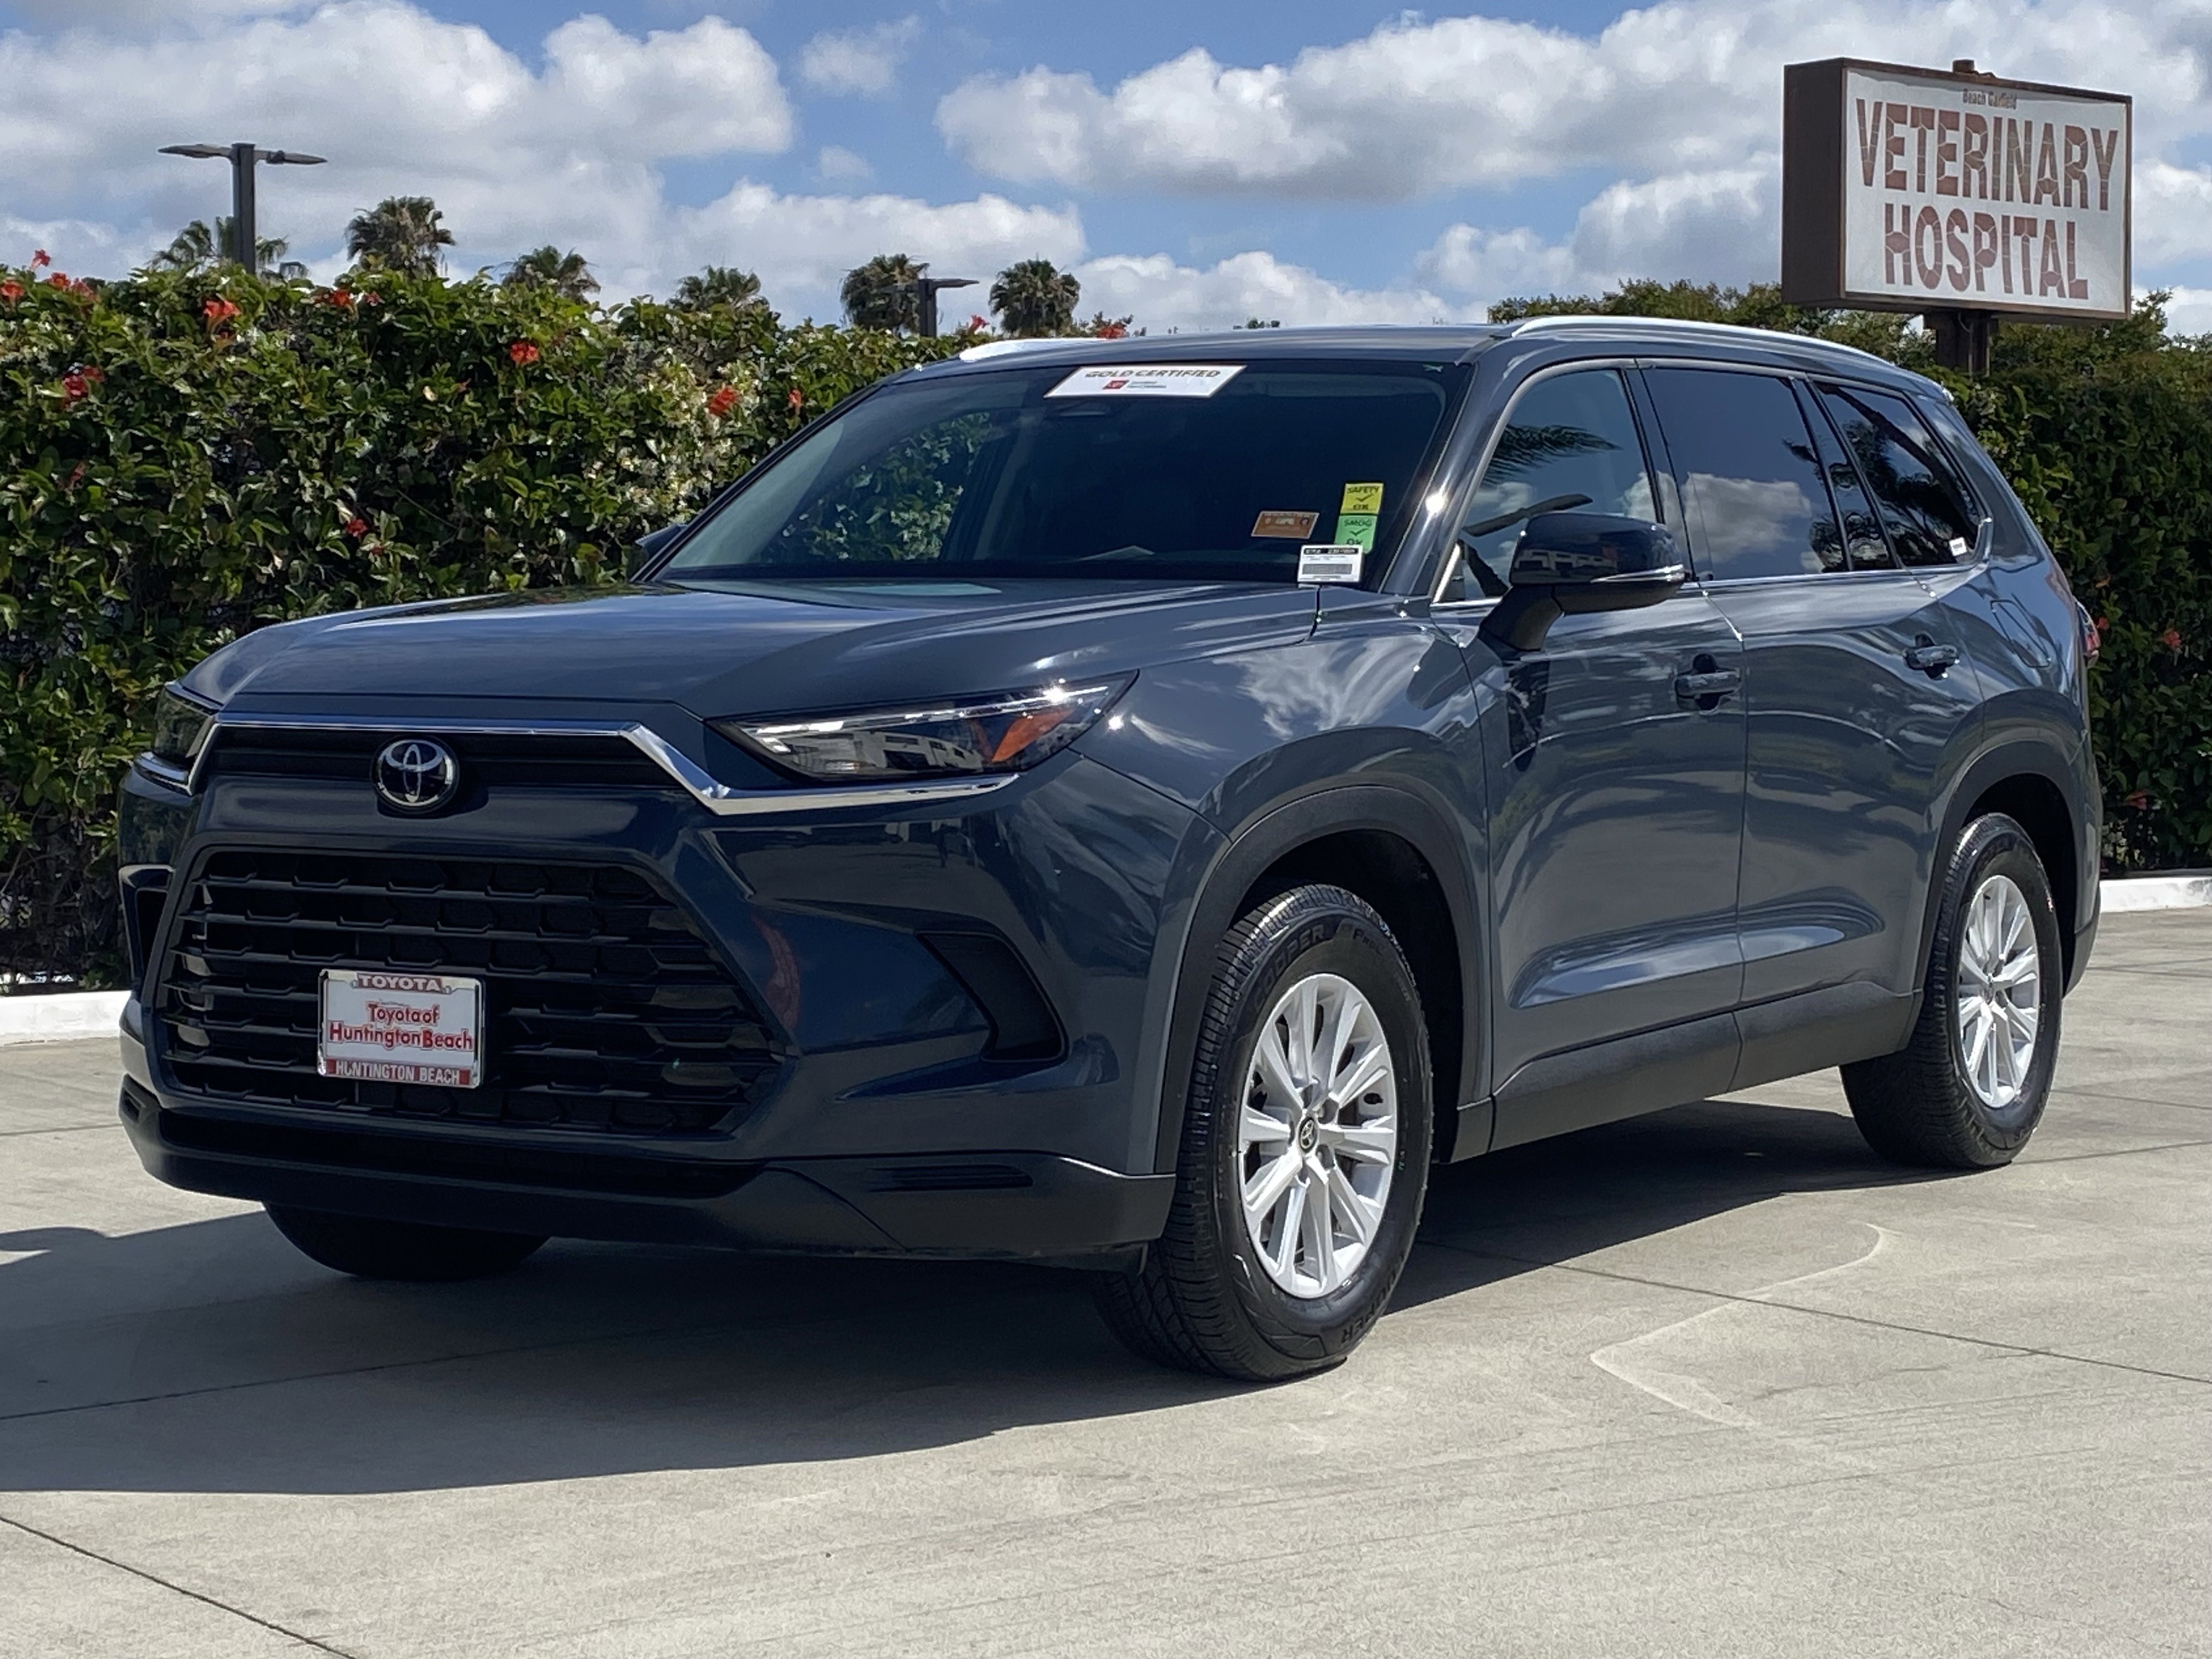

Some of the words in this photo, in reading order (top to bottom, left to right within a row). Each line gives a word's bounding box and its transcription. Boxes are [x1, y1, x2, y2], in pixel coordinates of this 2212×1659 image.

[1855, 98, 2119, 211] VETERINARY
[1884, 202, 2088, 300] HOSPITAL
[1085, 370, 1132, 378] GOLD
[1135, 370, 1221, 378] CERTIFIED
[1346, 486, 1380, 494] SAFETY
[1254, 924, 1324, 1013] COOPER
[358, 974, 441, 991] TOYOTA
[335, 1060, 414, 1081] HUNTINGTON
[419, 1066, 460, 1085] BEACH
